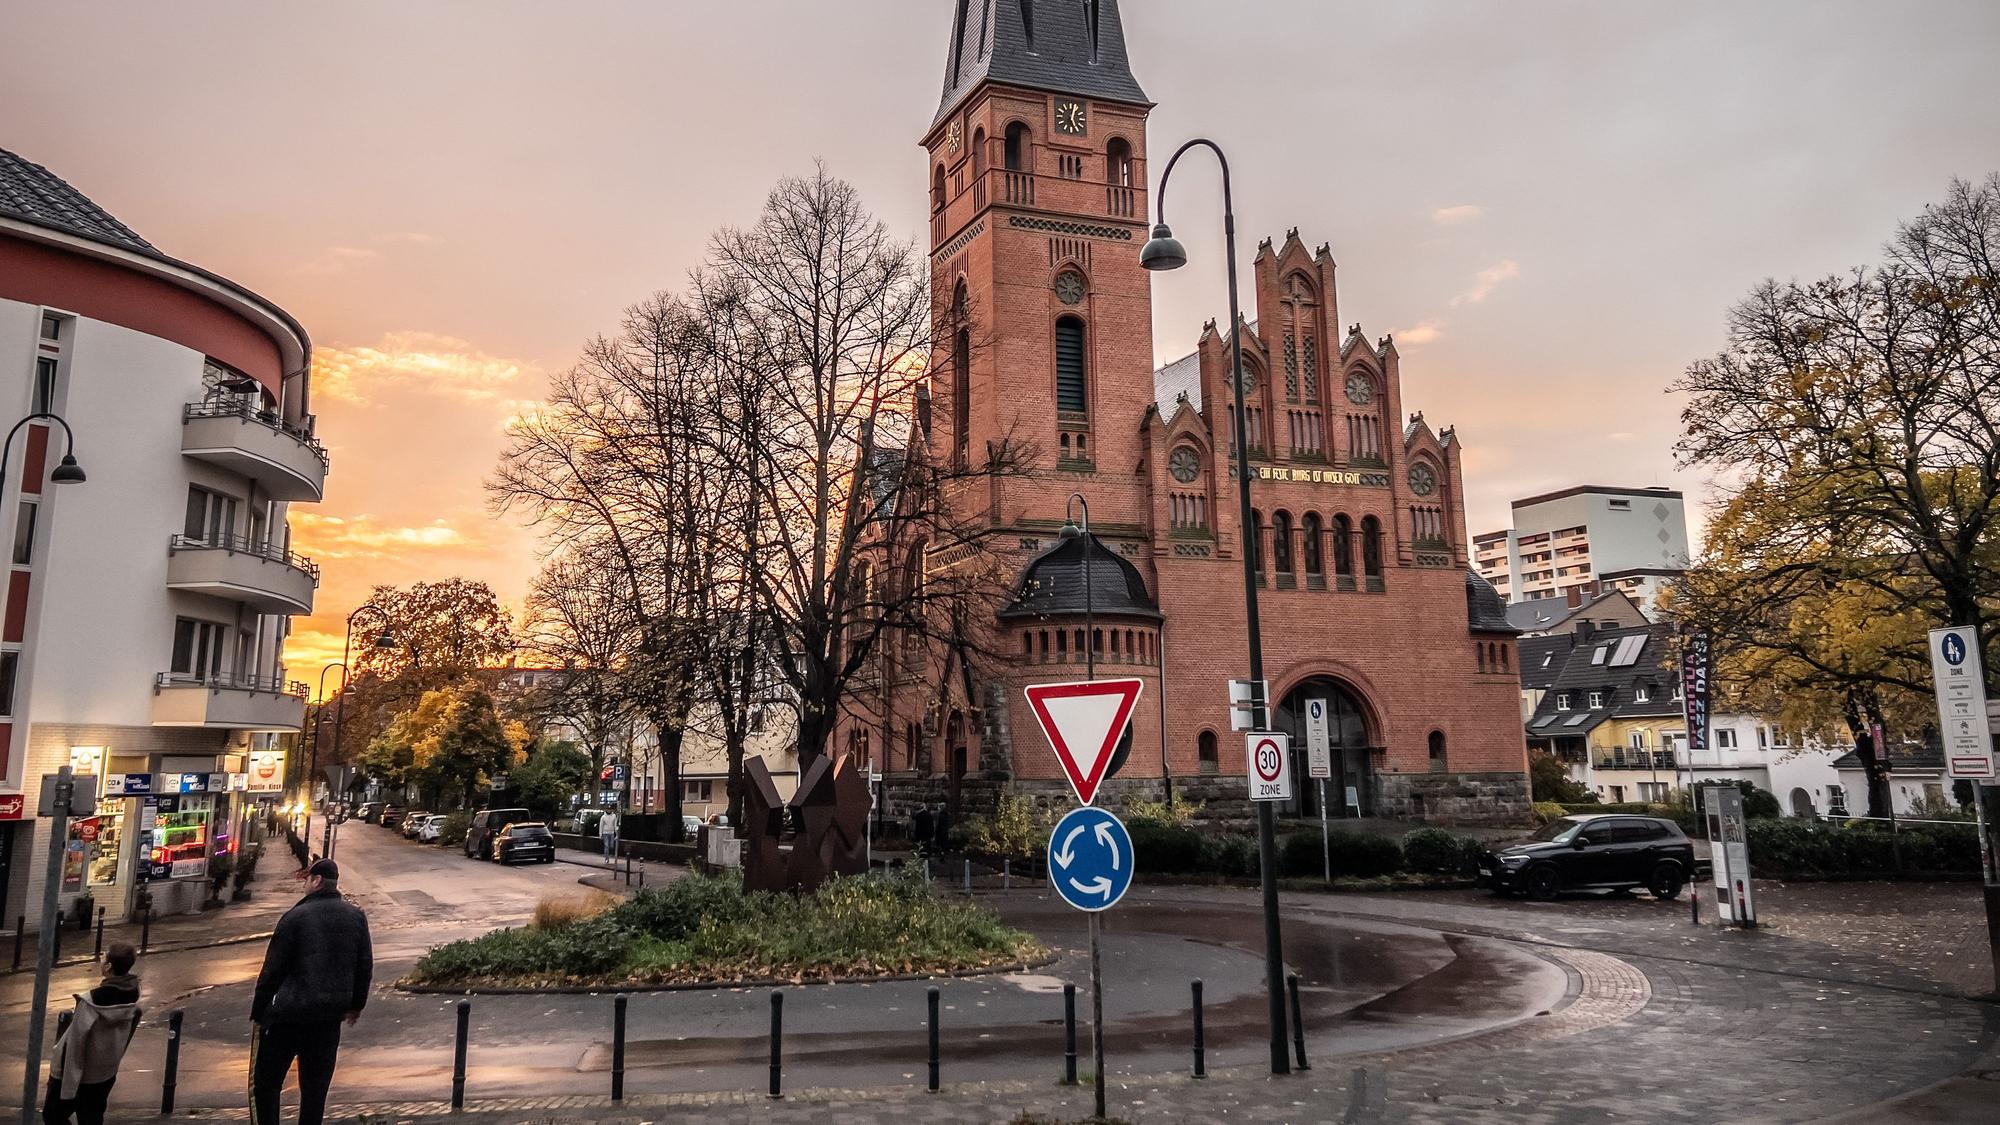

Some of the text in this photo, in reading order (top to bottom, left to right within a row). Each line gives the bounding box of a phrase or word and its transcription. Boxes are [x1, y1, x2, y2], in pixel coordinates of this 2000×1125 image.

[1696, 699, 1705, 748] JAZZ
[1260, 750, 1277, 770] 30
[615, 766, 623, 779] P
[1260, 784, 1281, 796] ZONE
